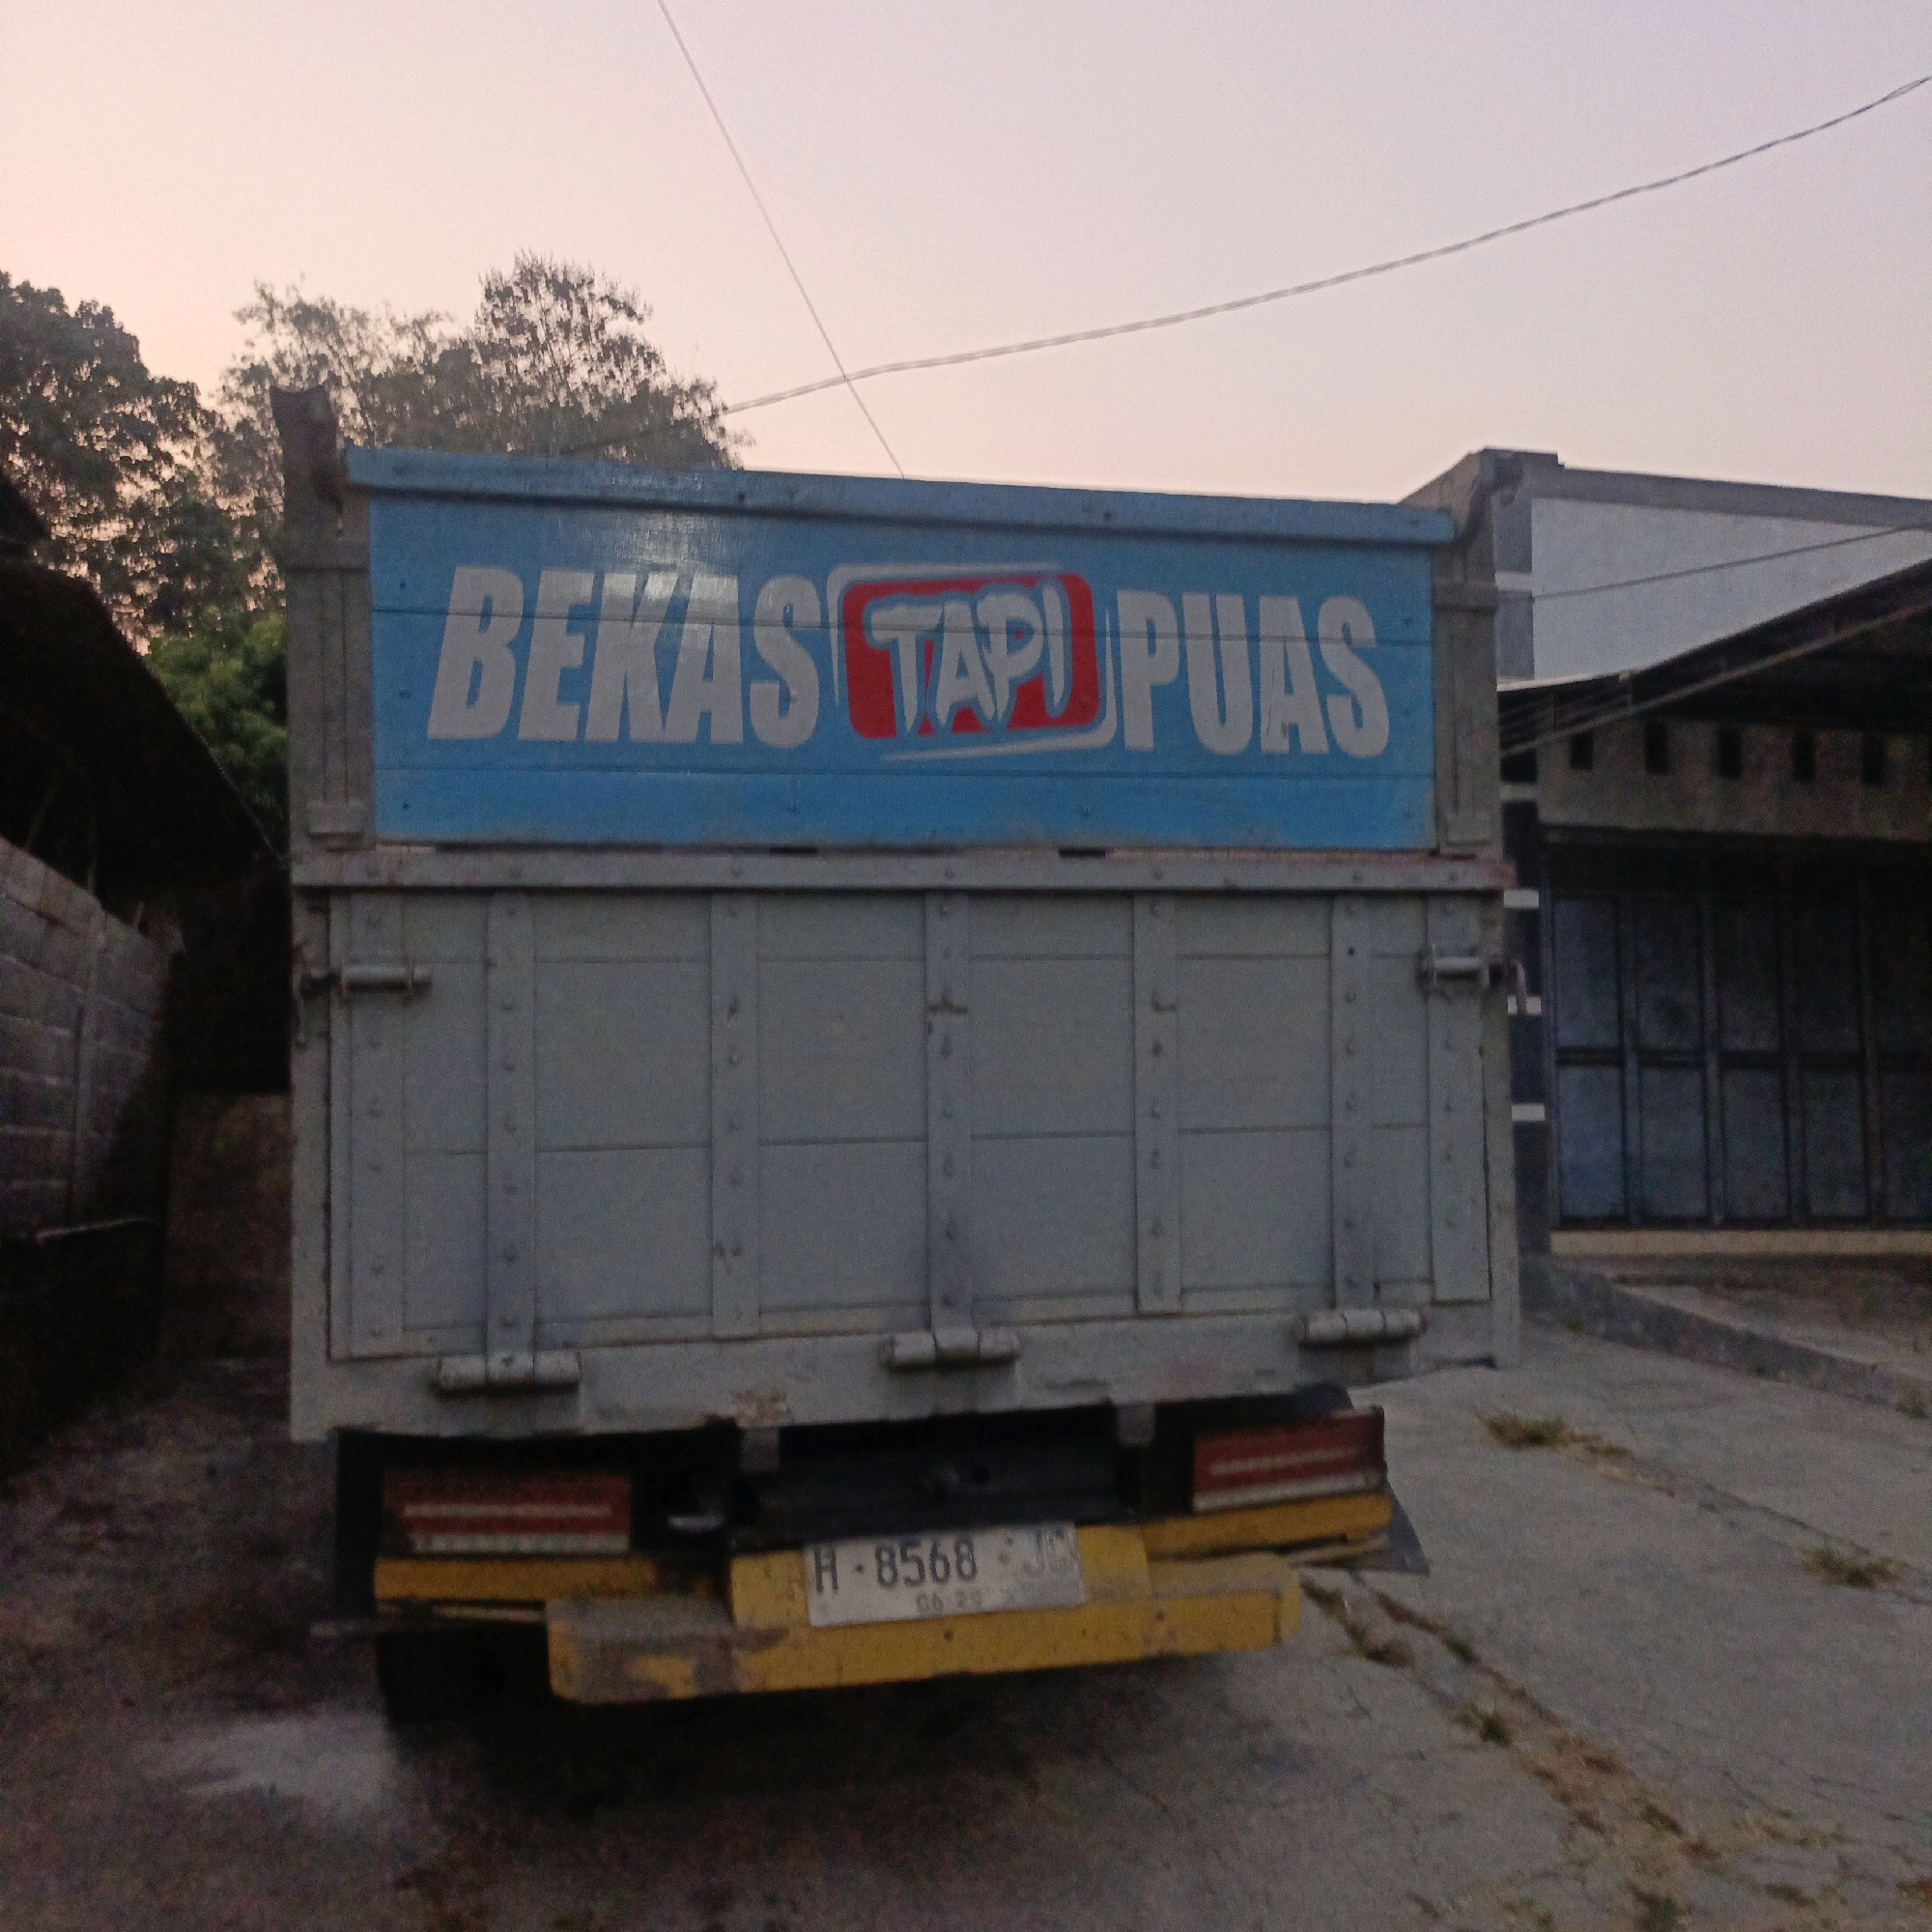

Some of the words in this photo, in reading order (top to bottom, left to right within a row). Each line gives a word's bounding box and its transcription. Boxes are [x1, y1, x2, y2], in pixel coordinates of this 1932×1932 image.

[427, 565, 821, 749] BEKAS
[869, 583, 1065, 734] TAPI
[1117, 589, 1390, 758] PUAS
[813, 1545, 839, 1595] H
[874, 1535, 978, 1590] 8568
